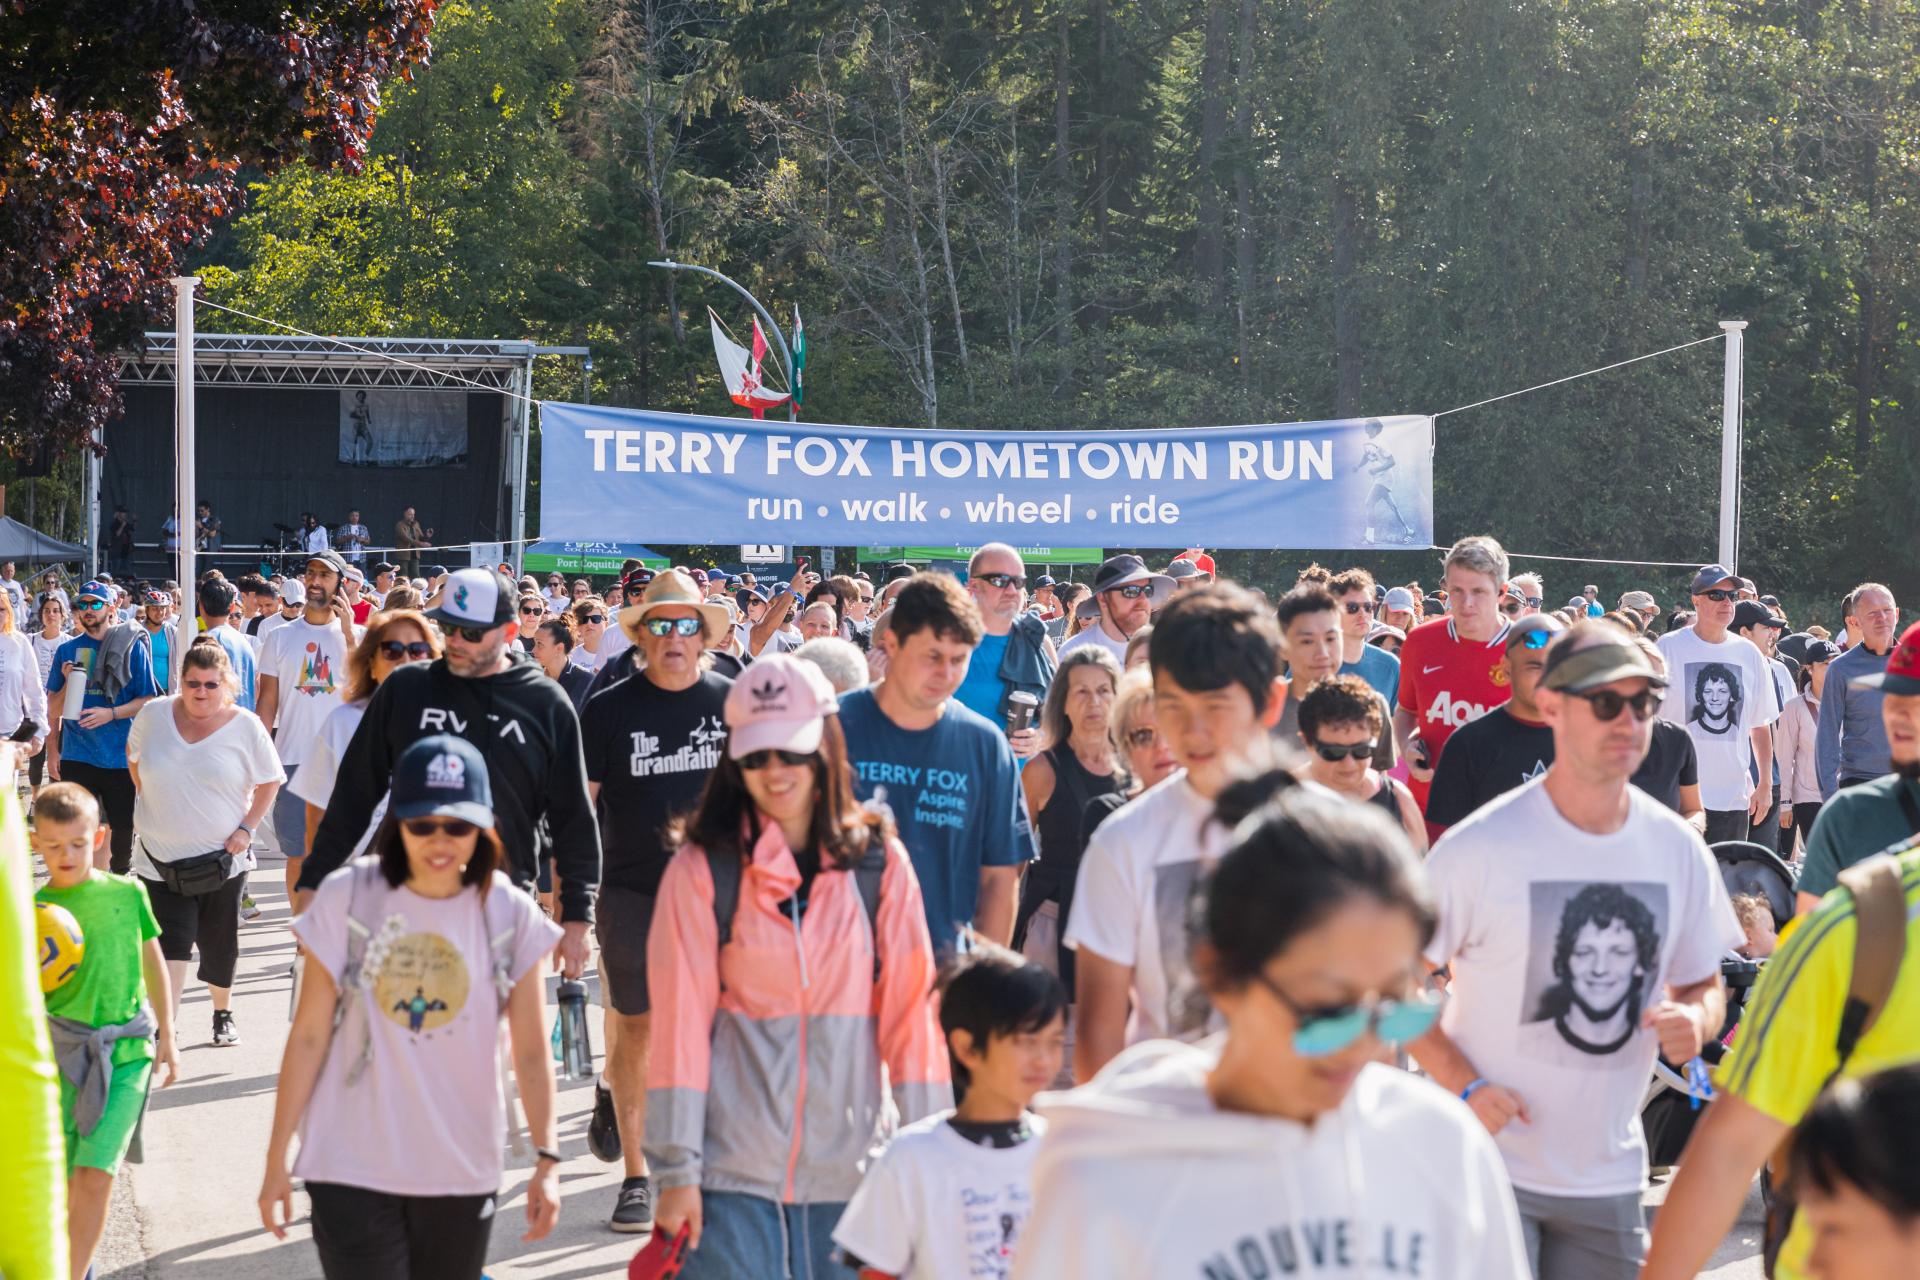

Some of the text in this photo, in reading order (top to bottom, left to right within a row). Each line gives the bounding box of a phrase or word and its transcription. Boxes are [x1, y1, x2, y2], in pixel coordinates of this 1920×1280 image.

[585, 428, 1336, 482] TERRY FOX HOMETOWN RUN
[746, 490, 1181, 525] run walk wheel ride
[557, 557, 624, 571] Port Coquitla
[419, 707, 526, 744] RVA
[630, 731, 660, 755] The
[856, 761, 968, 793] TERRY FOX
[918, 789, 966, 811] Aspire
[914, 807, 964, 830] Inspire
[1201, 1217, 1425, 1280] NOUVELE
